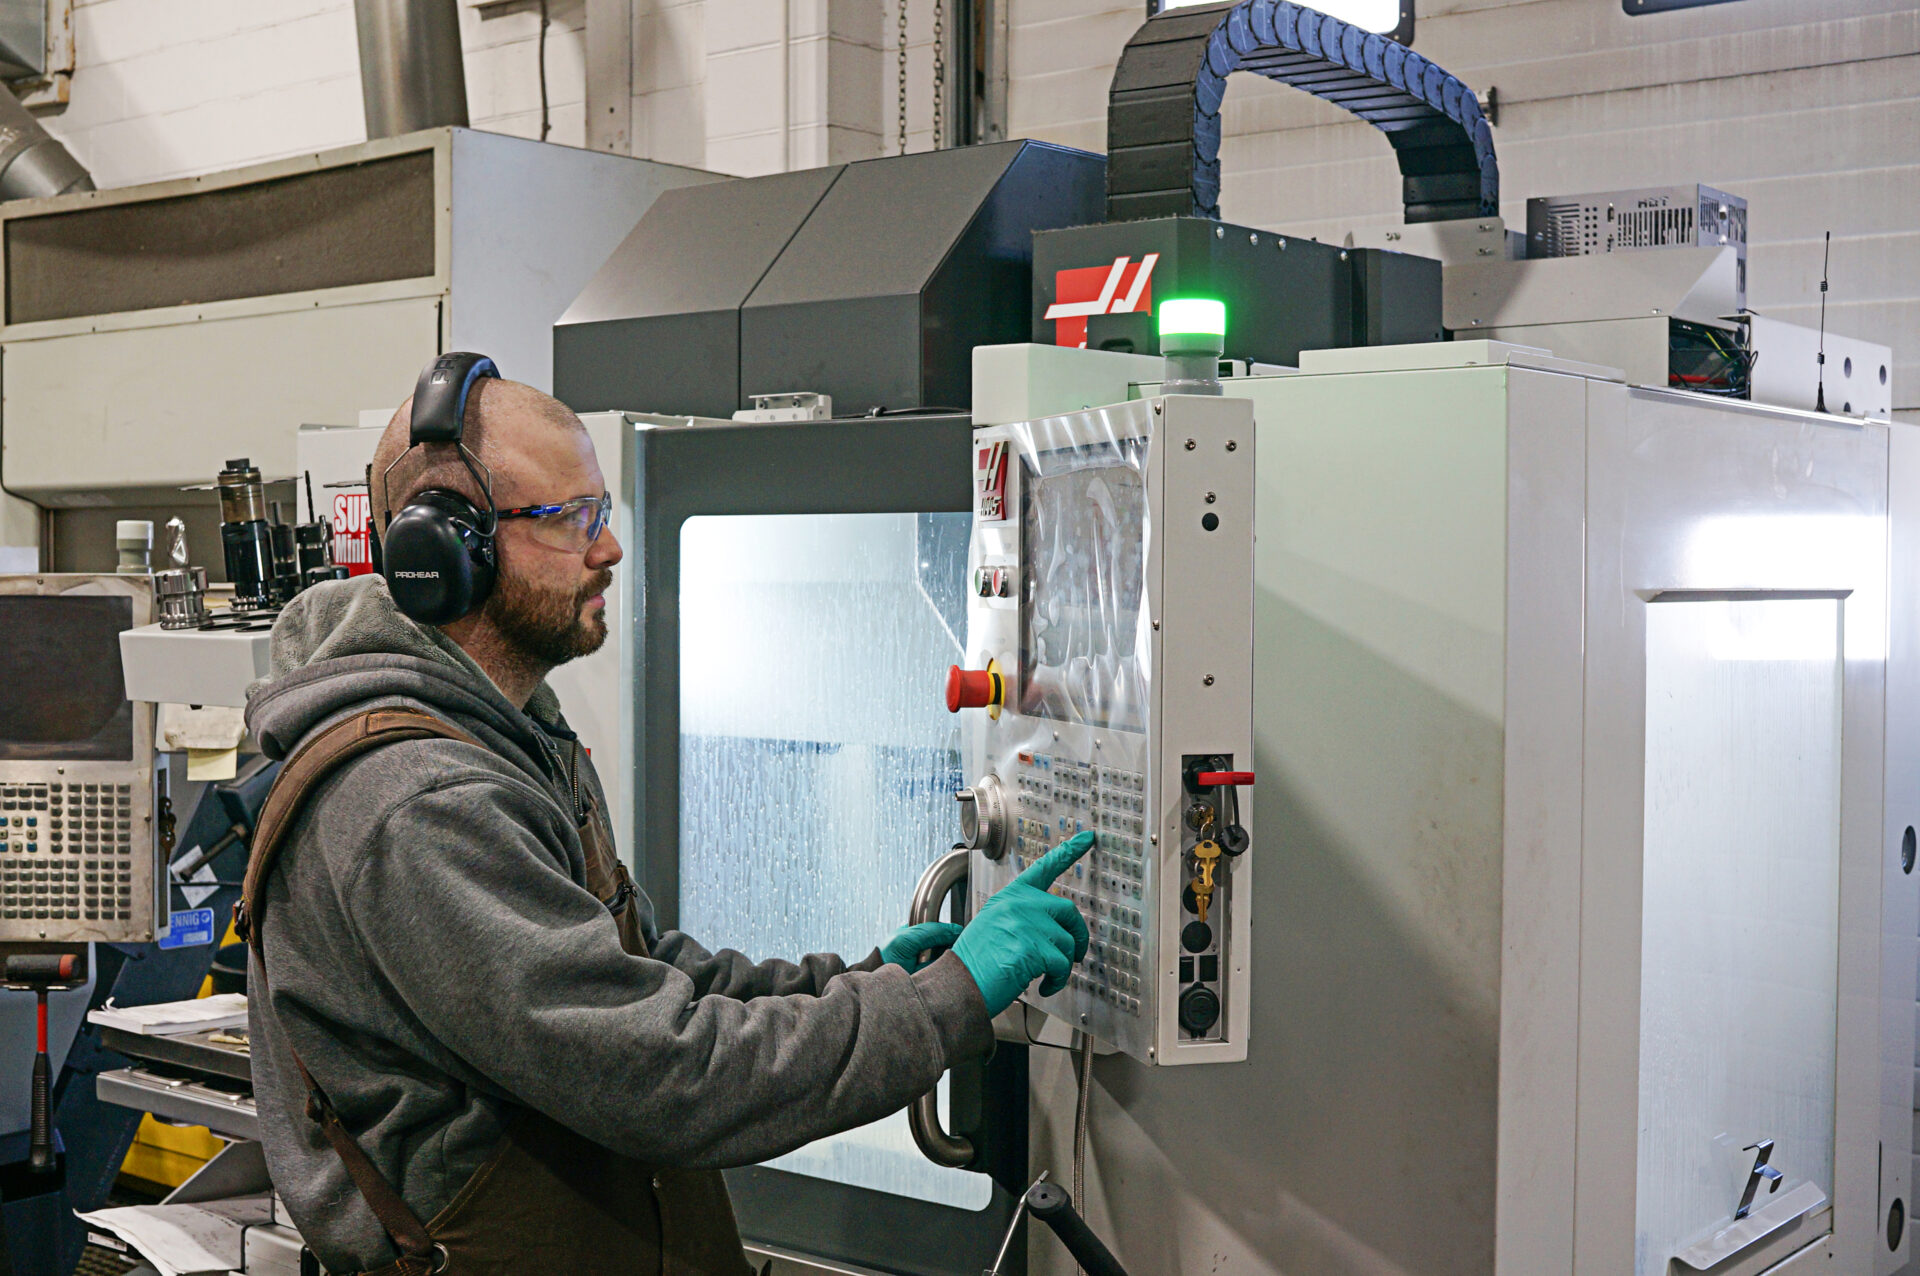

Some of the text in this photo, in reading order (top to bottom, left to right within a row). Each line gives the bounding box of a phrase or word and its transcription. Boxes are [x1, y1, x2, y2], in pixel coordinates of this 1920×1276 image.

[334, 494, 373, 533] SUP
[335, 534, 366, 563] Mini
[395, 571, 439, 579] PROHEAR
[170, 911, 200, 928] ENNIG
